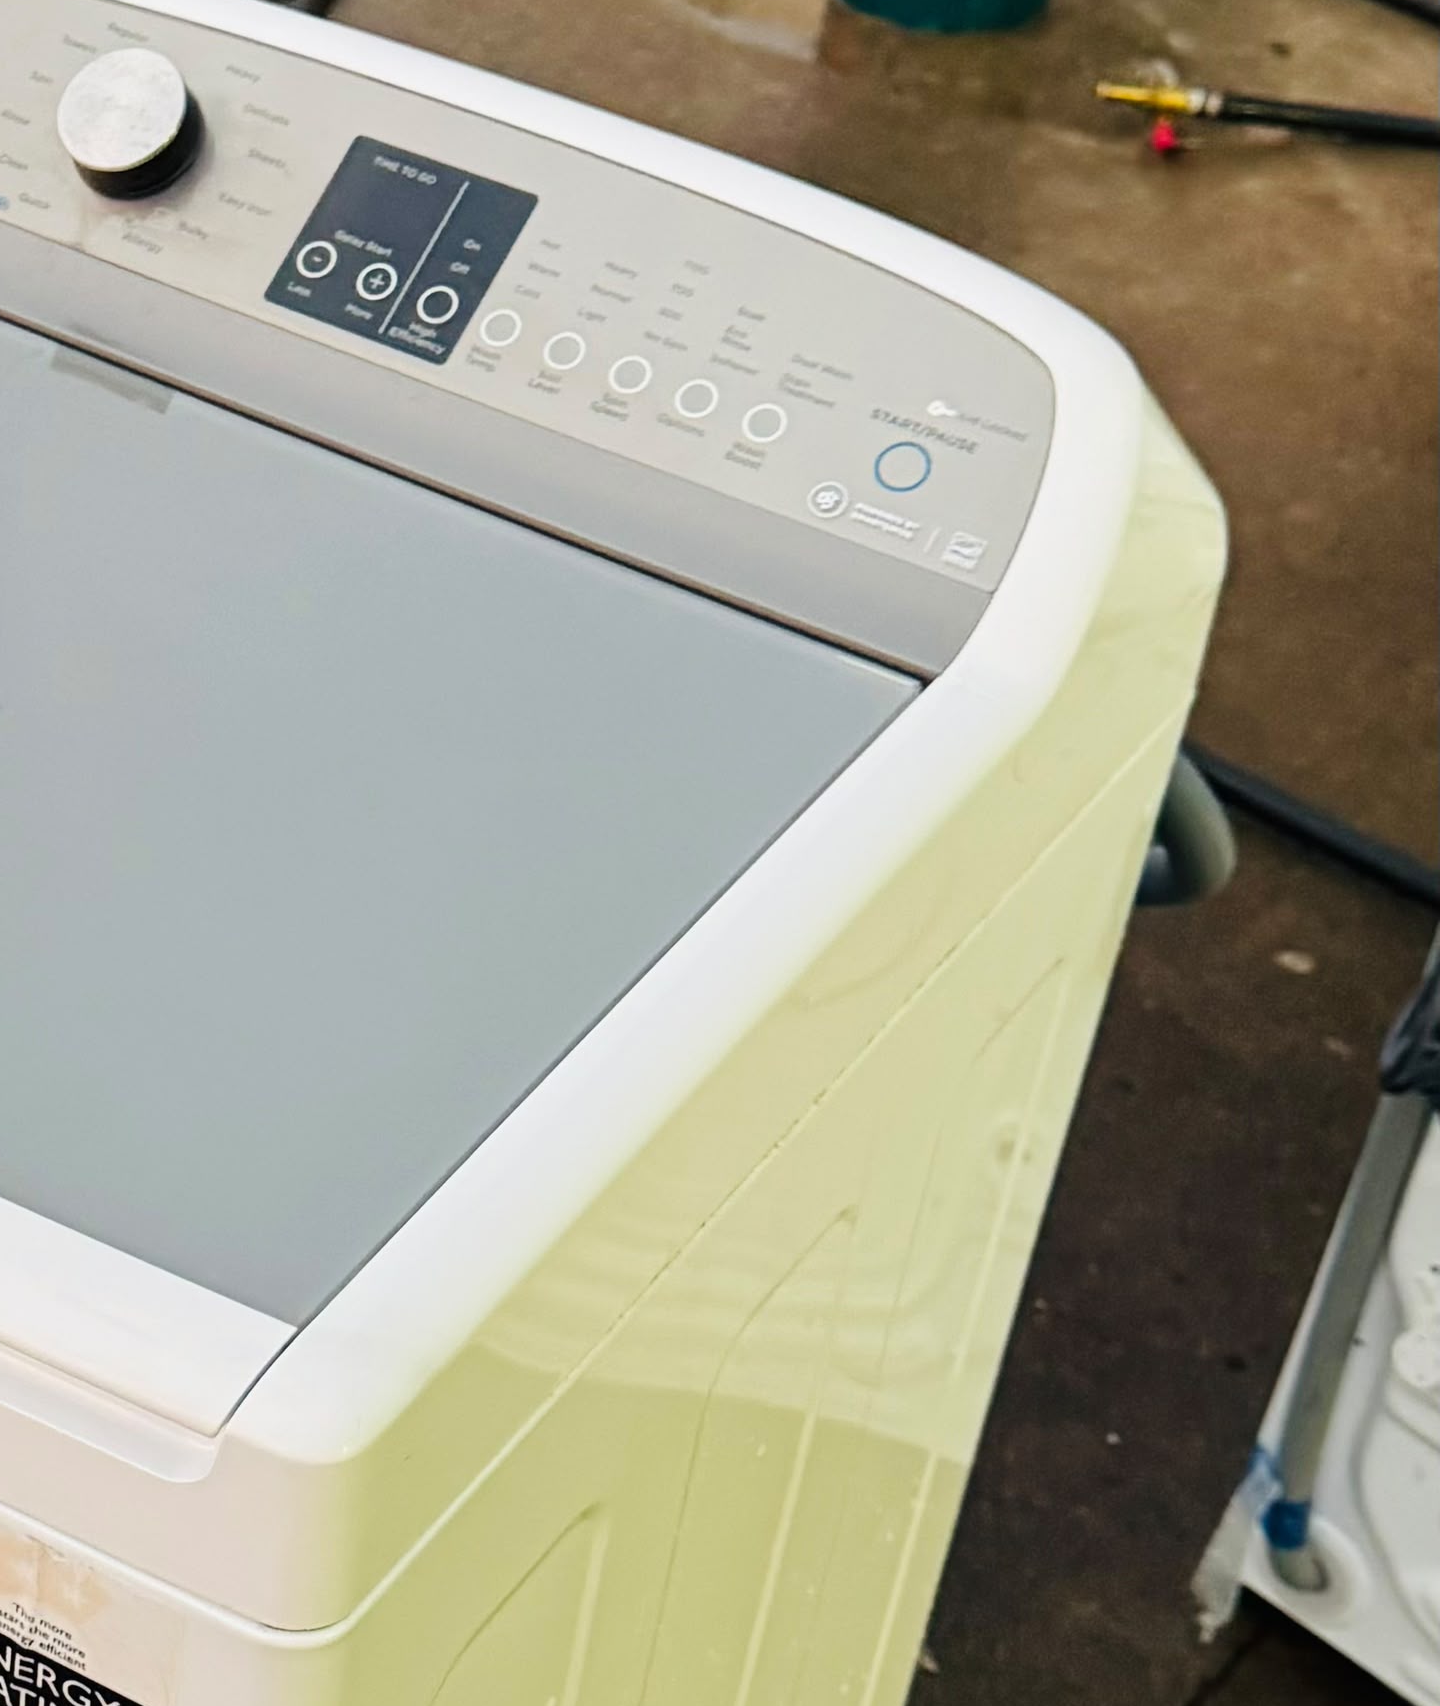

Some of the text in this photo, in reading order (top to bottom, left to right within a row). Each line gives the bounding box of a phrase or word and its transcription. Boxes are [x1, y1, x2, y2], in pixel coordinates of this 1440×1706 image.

[870, 408, 981, 455] START/PAUSE
[12, 1602, 73, 1640] The more
[29, 1623, 50, 1639] the
[52, 1635, 87, 1659] more
[38, 1640, 87, 1671] efficient
